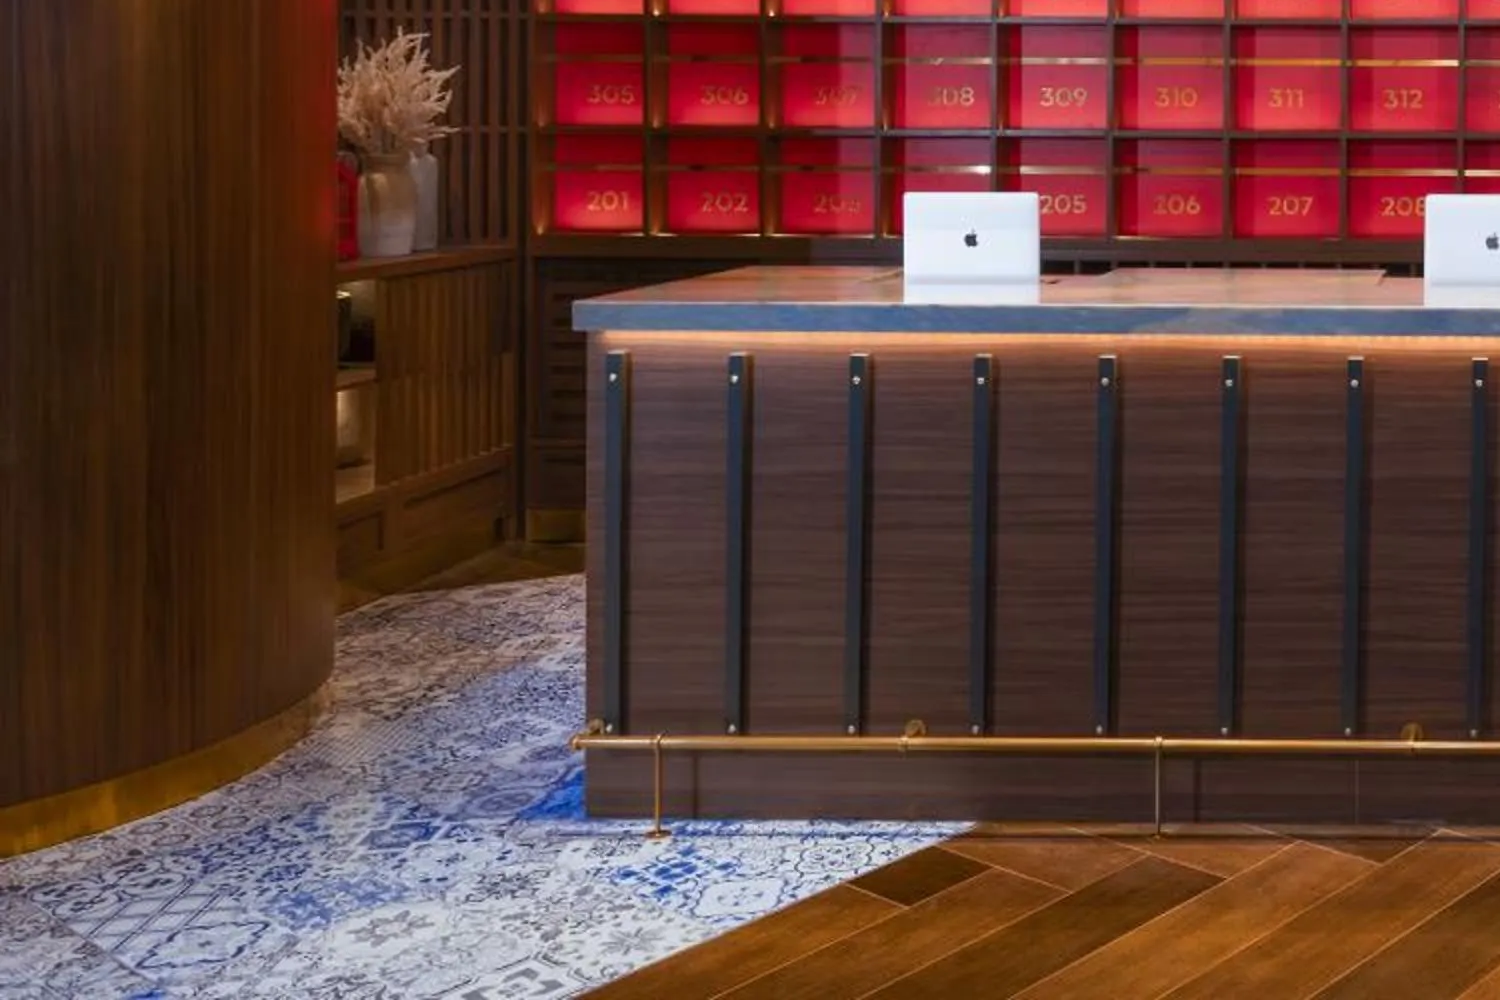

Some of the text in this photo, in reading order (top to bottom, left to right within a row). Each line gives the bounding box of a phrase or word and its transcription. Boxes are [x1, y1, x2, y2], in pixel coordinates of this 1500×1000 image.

[1039, 86, 1088, 108] 309
[1154, 88, 1198, 109] 310
[1268, 88, 1304, 109] 311
[1382, 88, 1424, 110] 312
[586, 190, 628, 212] 201
[700, 191, 749, 214] 202
[1039, 194, 1088, 215] 205
[1154, 195, 1201, 215] 206
[1268, 196, 1314, 216] 207
[1382, 196, 1425, 217] 208
